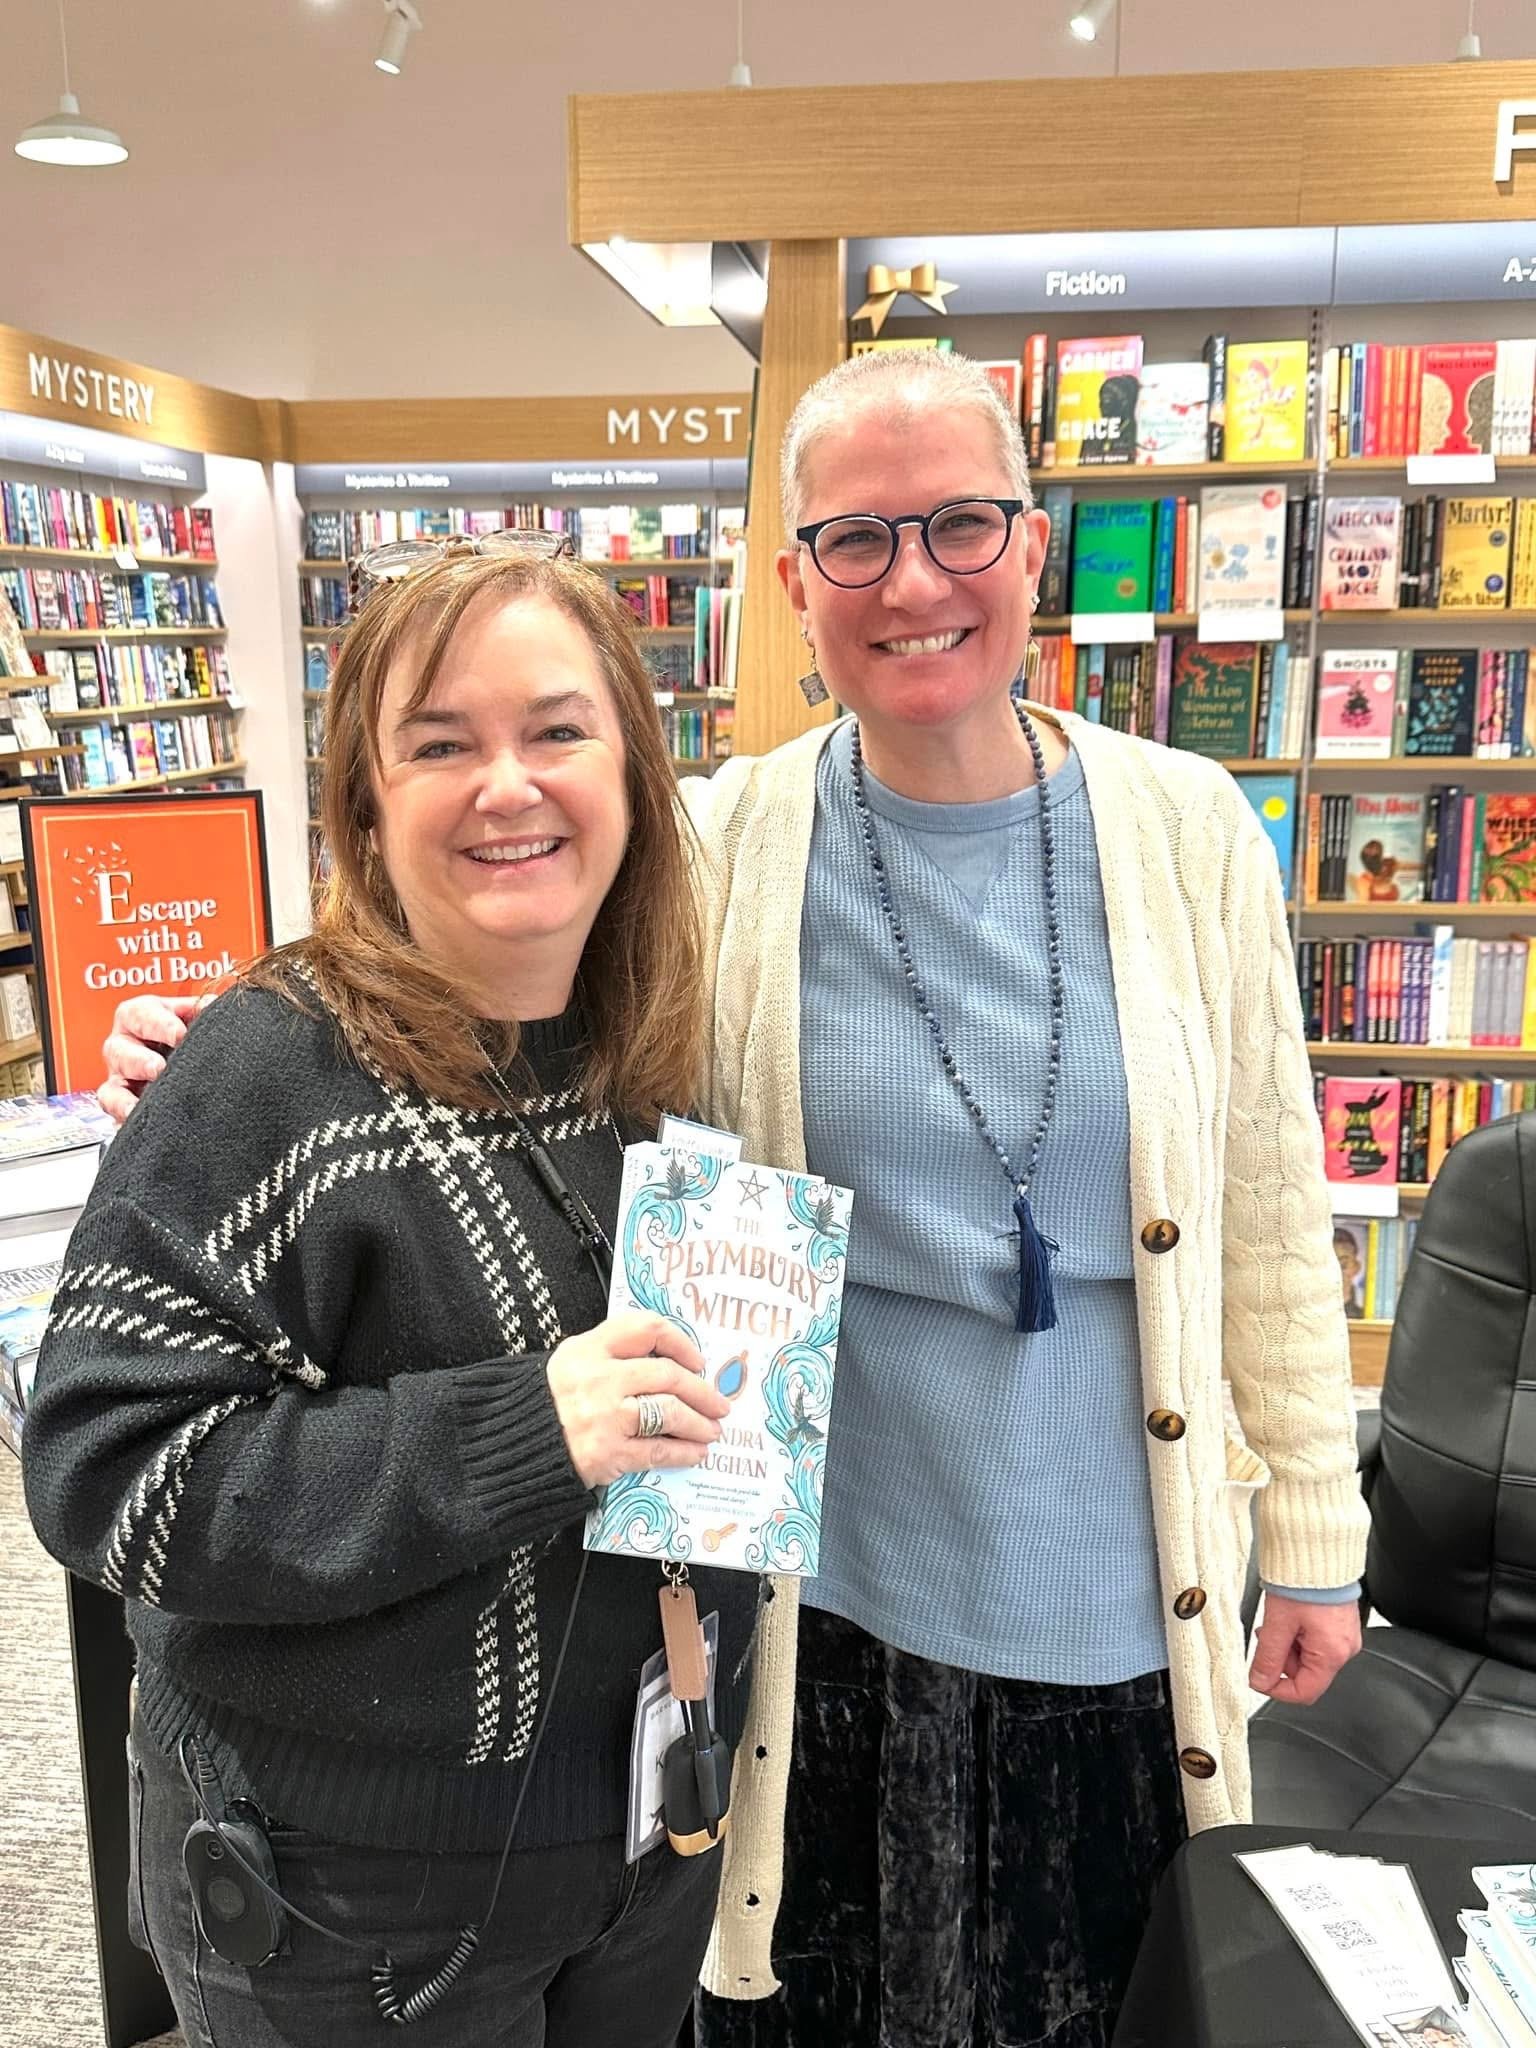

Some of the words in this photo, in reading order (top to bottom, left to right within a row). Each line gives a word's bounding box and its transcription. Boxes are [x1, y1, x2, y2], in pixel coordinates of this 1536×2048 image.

[1046, 271, 1126, 297] Fiction
[29, 352, 155, 425] MYSTERY
[606, 408, 742, 444] MYST
[1059, 416, 1122, 442] GRACE
[345, 473, 396, 490] Mysteries
[408, 473, 450, 487] Thrillers
[552, 470, 603, 487] Mysteries
[615, 470, 659, 485] Thrillers
[1447, 501, 1511, 529] Martyr!
[1334, 658, 1387, 668] GHOSTS
[94, 871, 217, 926] Escape
[116, 925, 181, 955] with
[187, 930, 203, 950] a
[85, 957, 163, 990] Good
[168, 951, 240, 983] Book
[660, 1240, 823, 1311] PLYMBURY
[682, 1282, 793, 1340] WITCH
